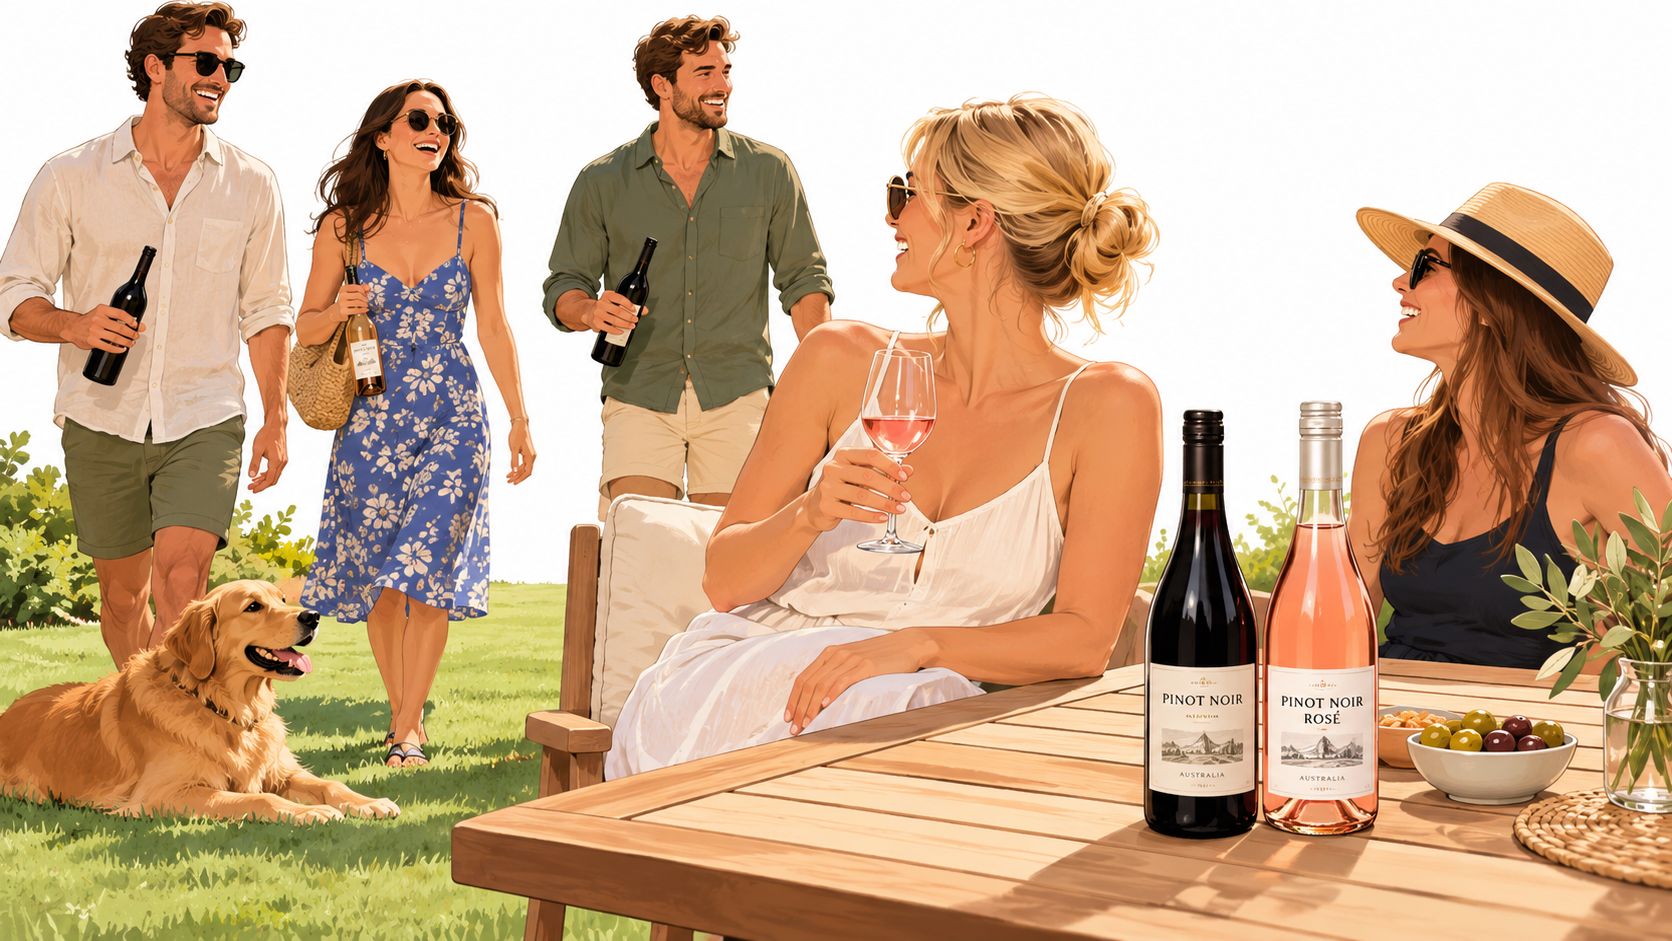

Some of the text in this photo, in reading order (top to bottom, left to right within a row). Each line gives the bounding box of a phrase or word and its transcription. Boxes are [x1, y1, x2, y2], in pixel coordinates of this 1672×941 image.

[1162, 693, 1243, 706] PINOT NOIR
[1281, 695, 1364, 708] PINOT NOIR
[1304, 710, 1341, 724] ROSÉ
